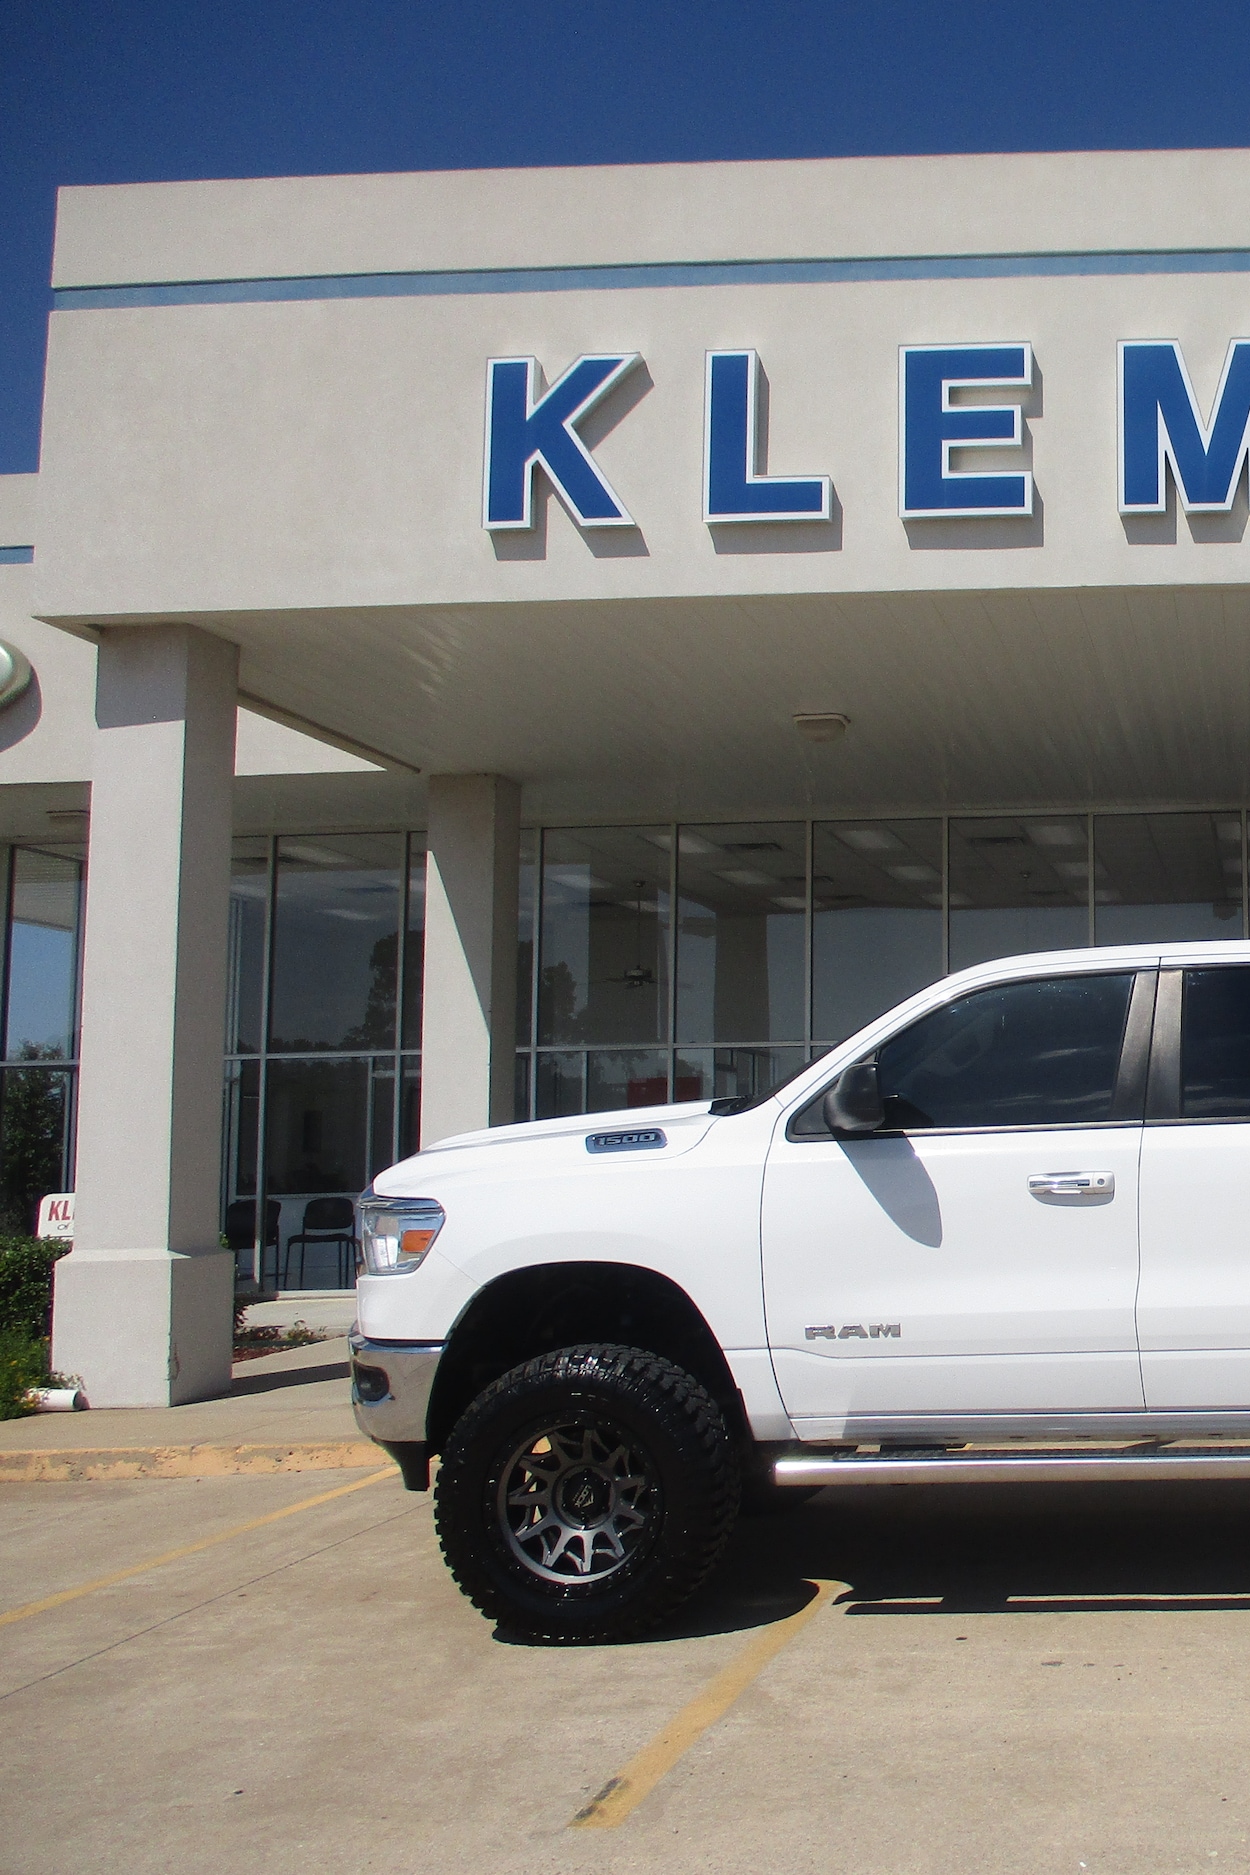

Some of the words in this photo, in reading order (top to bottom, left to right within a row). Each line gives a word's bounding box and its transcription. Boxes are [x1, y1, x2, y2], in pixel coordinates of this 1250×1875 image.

[598, 1132, 656, 1146] 1500
[48, 1200, 75, 1221] KL
[804, 1323, 901, 1340] RAM
